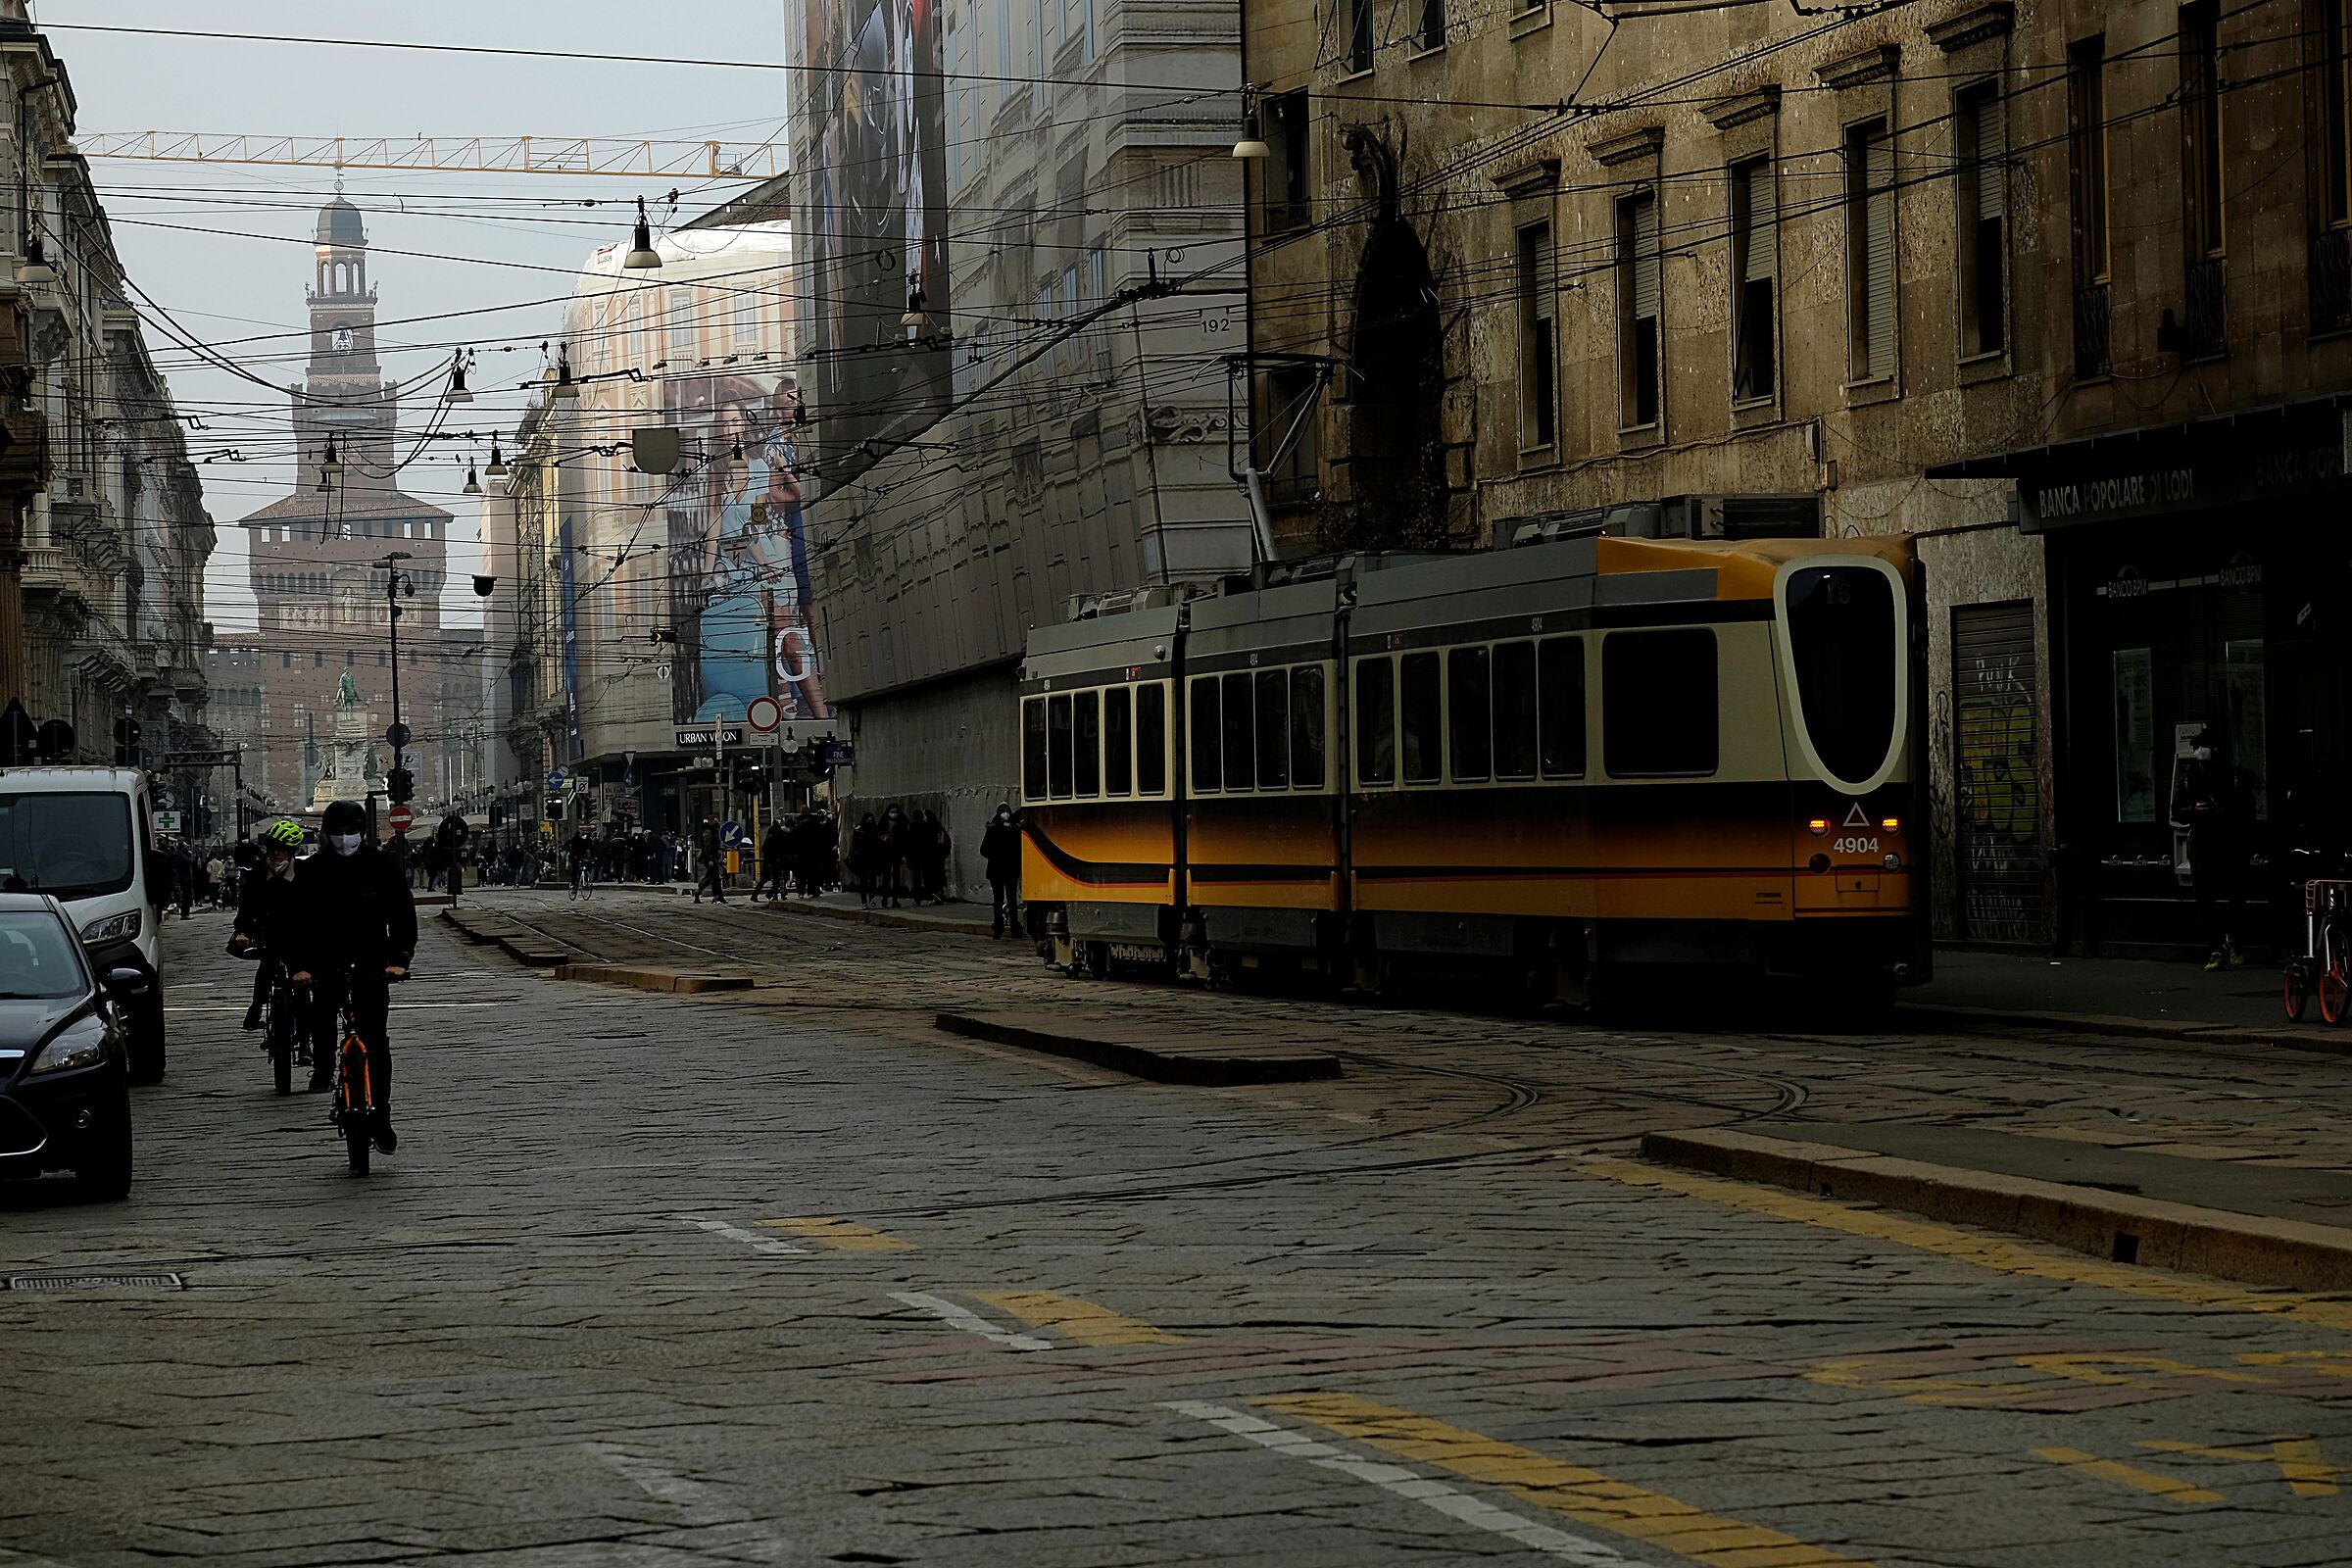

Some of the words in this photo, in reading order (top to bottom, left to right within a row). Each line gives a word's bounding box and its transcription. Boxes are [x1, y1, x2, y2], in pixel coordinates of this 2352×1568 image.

[1200, 318, 1230, 334] 192
[2038, 485, 2082, 518] BANCA
[2083, 475, 2145, 513] POPOLARE
[2149, 472, 2162, 504] DI
[2164, 468, 2194, 502] LODI
[2220, 565, 2246, 586] BANCO
[2247, 564, 2262, 583] BPM
[2108, 580, 2133, 599] BANCO
[2133, 578, 2148, 597] BPM
[679, 731, 707, 745] URBAN
[1833, 836, 1881, 855] 4904
